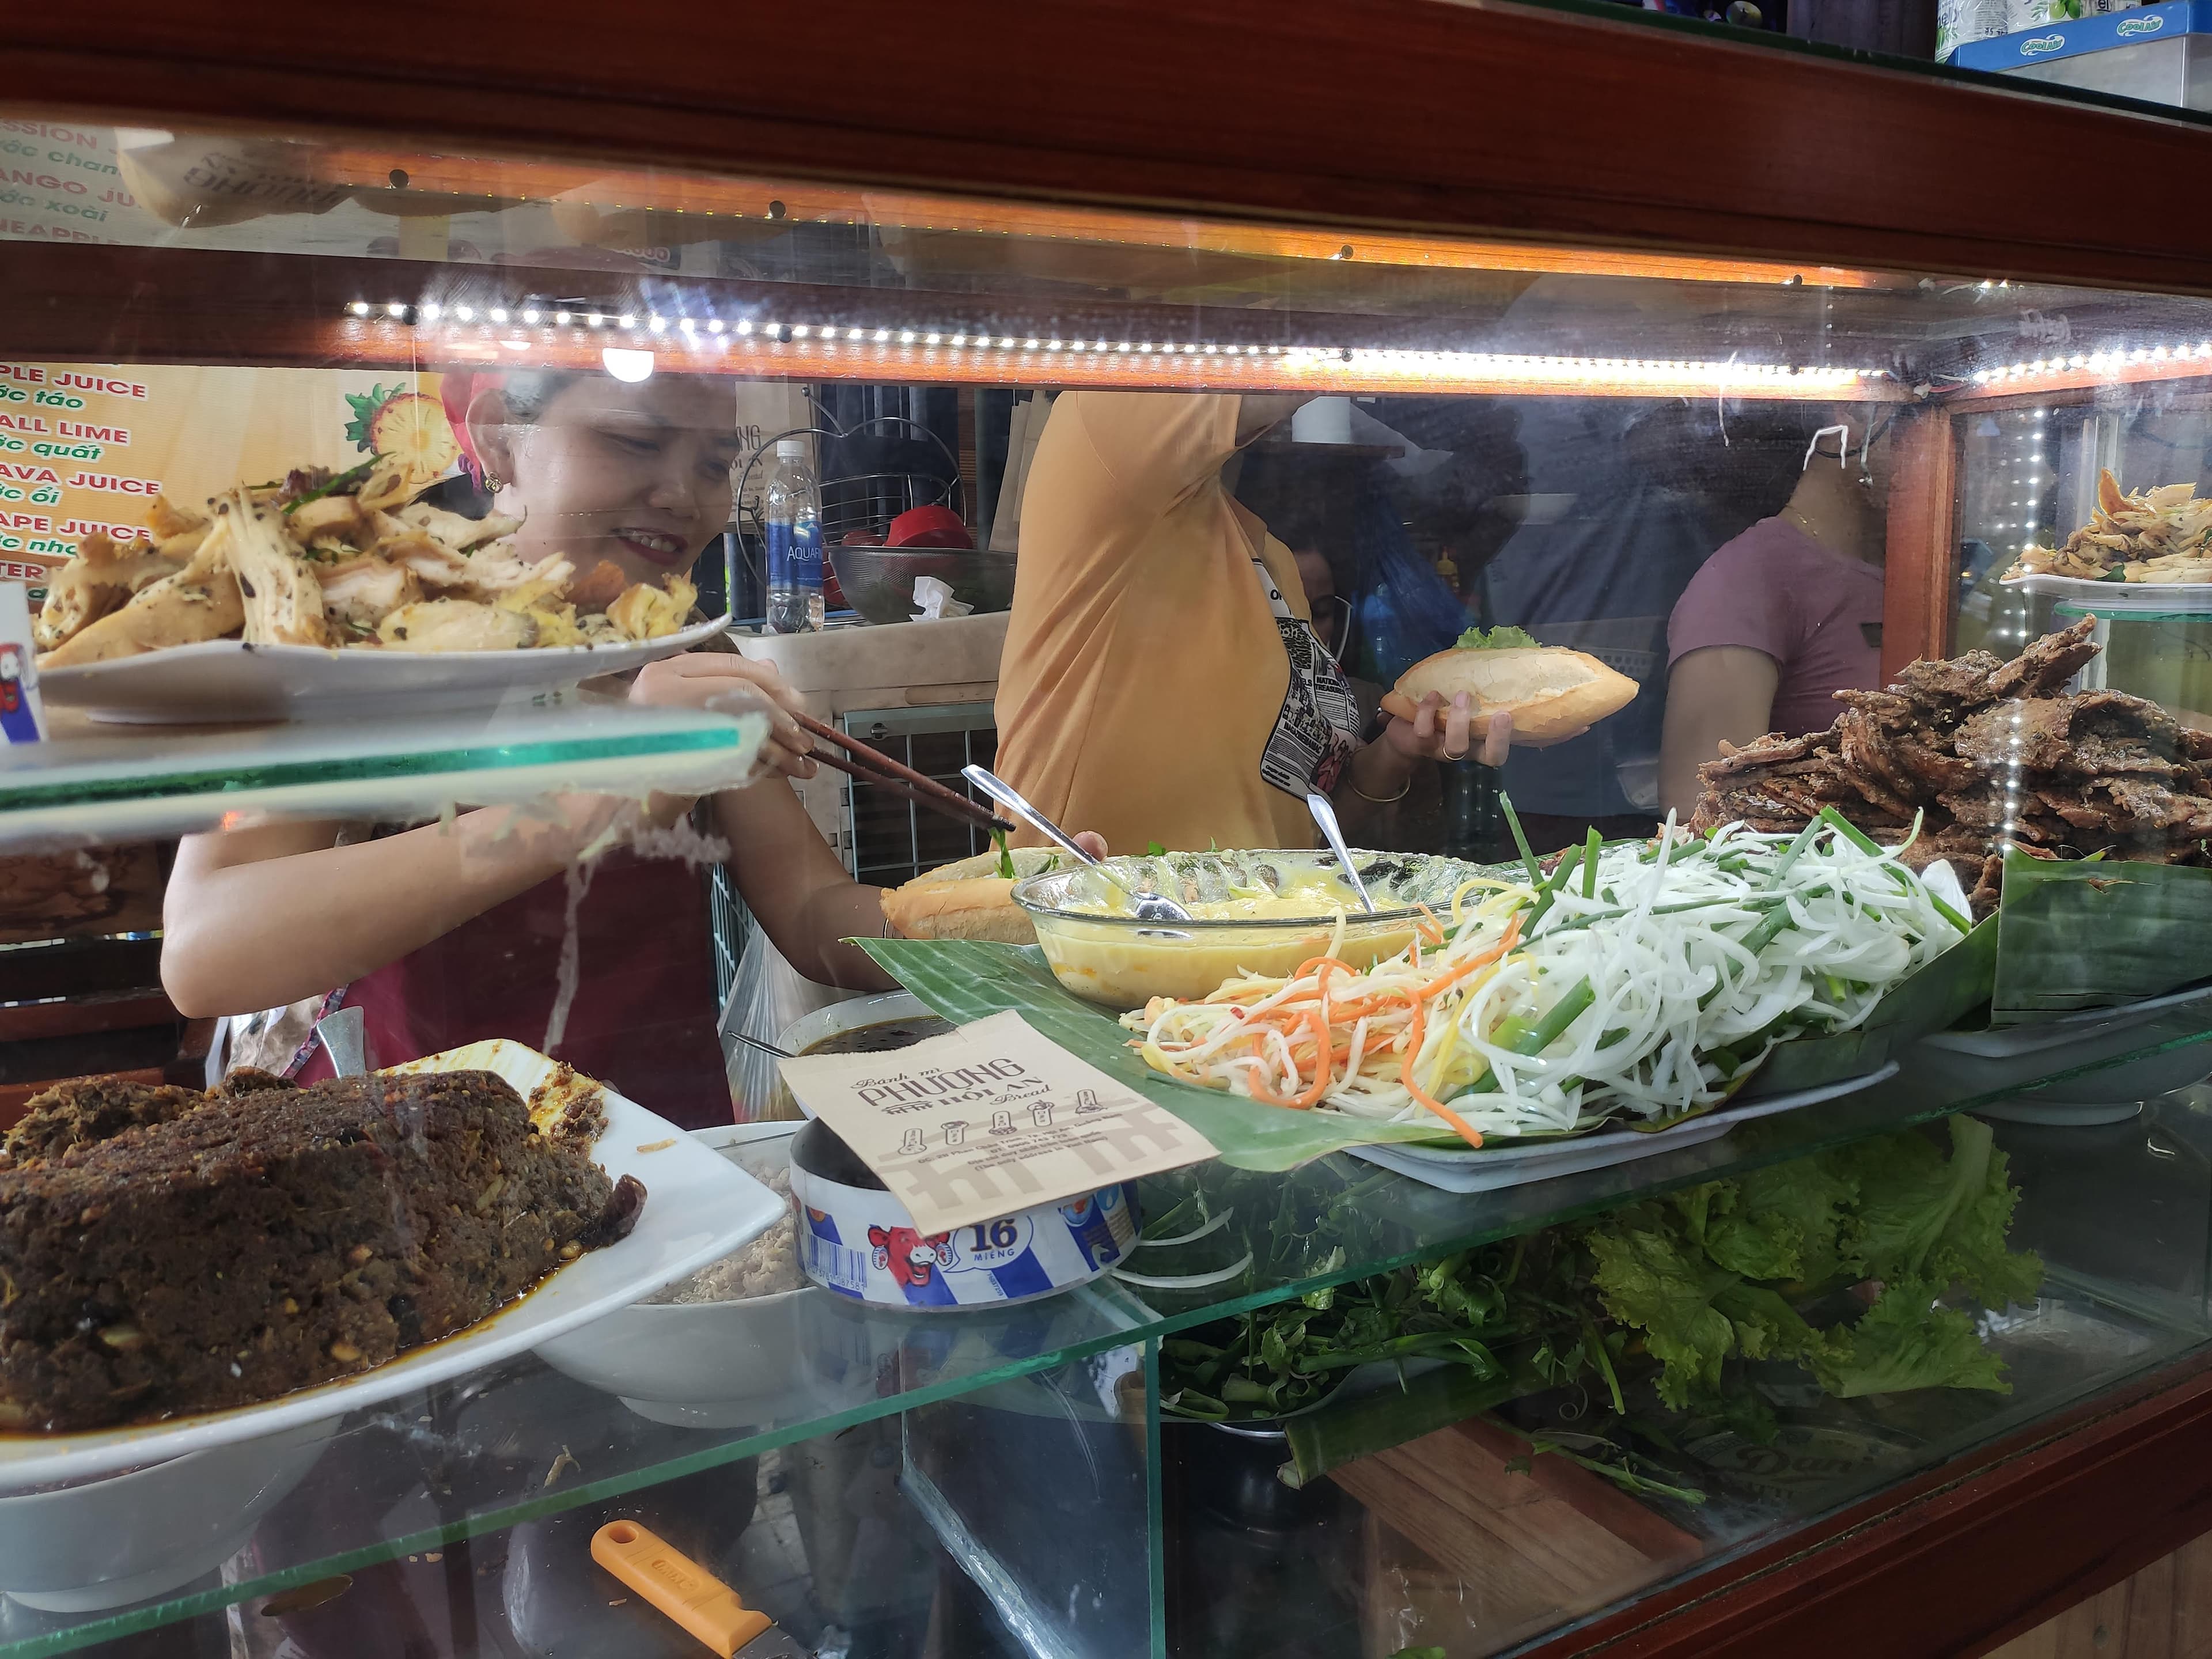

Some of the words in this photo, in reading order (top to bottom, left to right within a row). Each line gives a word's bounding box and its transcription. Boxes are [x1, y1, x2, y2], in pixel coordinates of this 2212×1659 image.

[48, 151, 122, 175] chan
[55, 374, 146, 398] JUICE
[36, 391, 83, 408] táo
[60, 422, 127, 443] LIME
[33, 444, 101, 460] quất
[69, 474, 160, 494] JUICE
[32, 486, 59, 503] ổi
[786, 546, 821, 562] AQUAF
[850, 1072, 910, 1089] Bánh
[989, 1084, 1054, 1105] Bread
[969, 1218, 1017, 1252] 16
